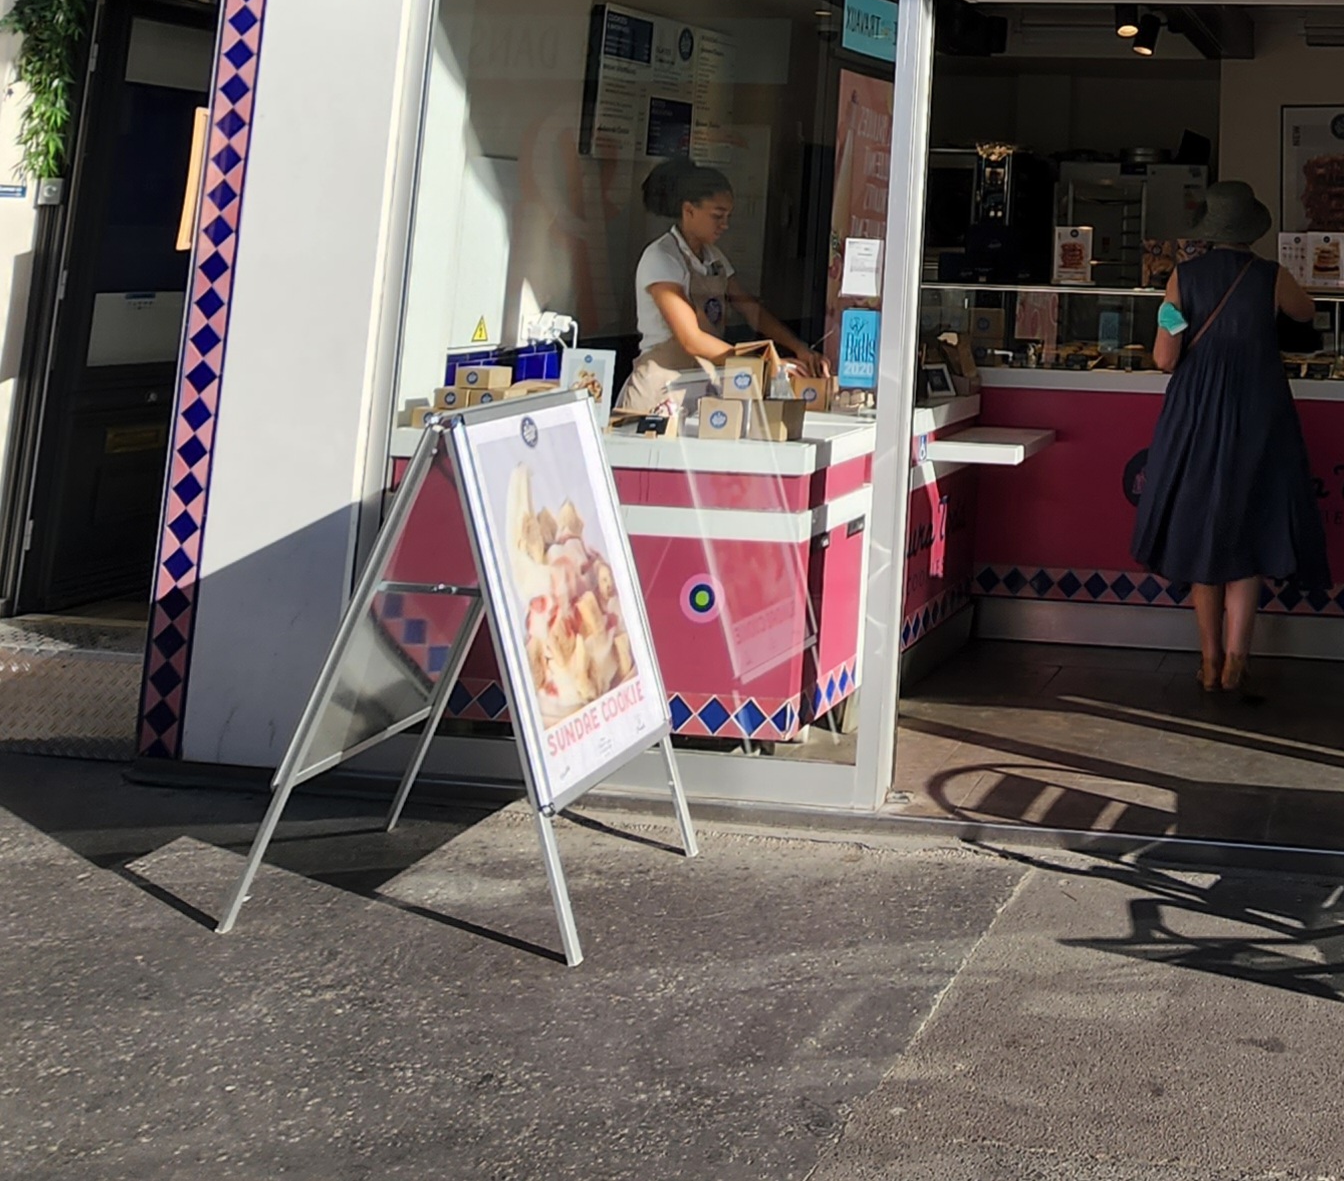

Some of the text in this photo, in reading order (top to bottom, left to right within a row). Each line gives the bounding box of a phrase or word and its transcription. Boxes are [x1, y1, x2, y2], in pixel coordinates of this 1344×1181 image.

[843, 362, 874, 376] 2020
[547, 707, 601, 757] SUNDAE
[601, 681, 645, 722] COOKIE
